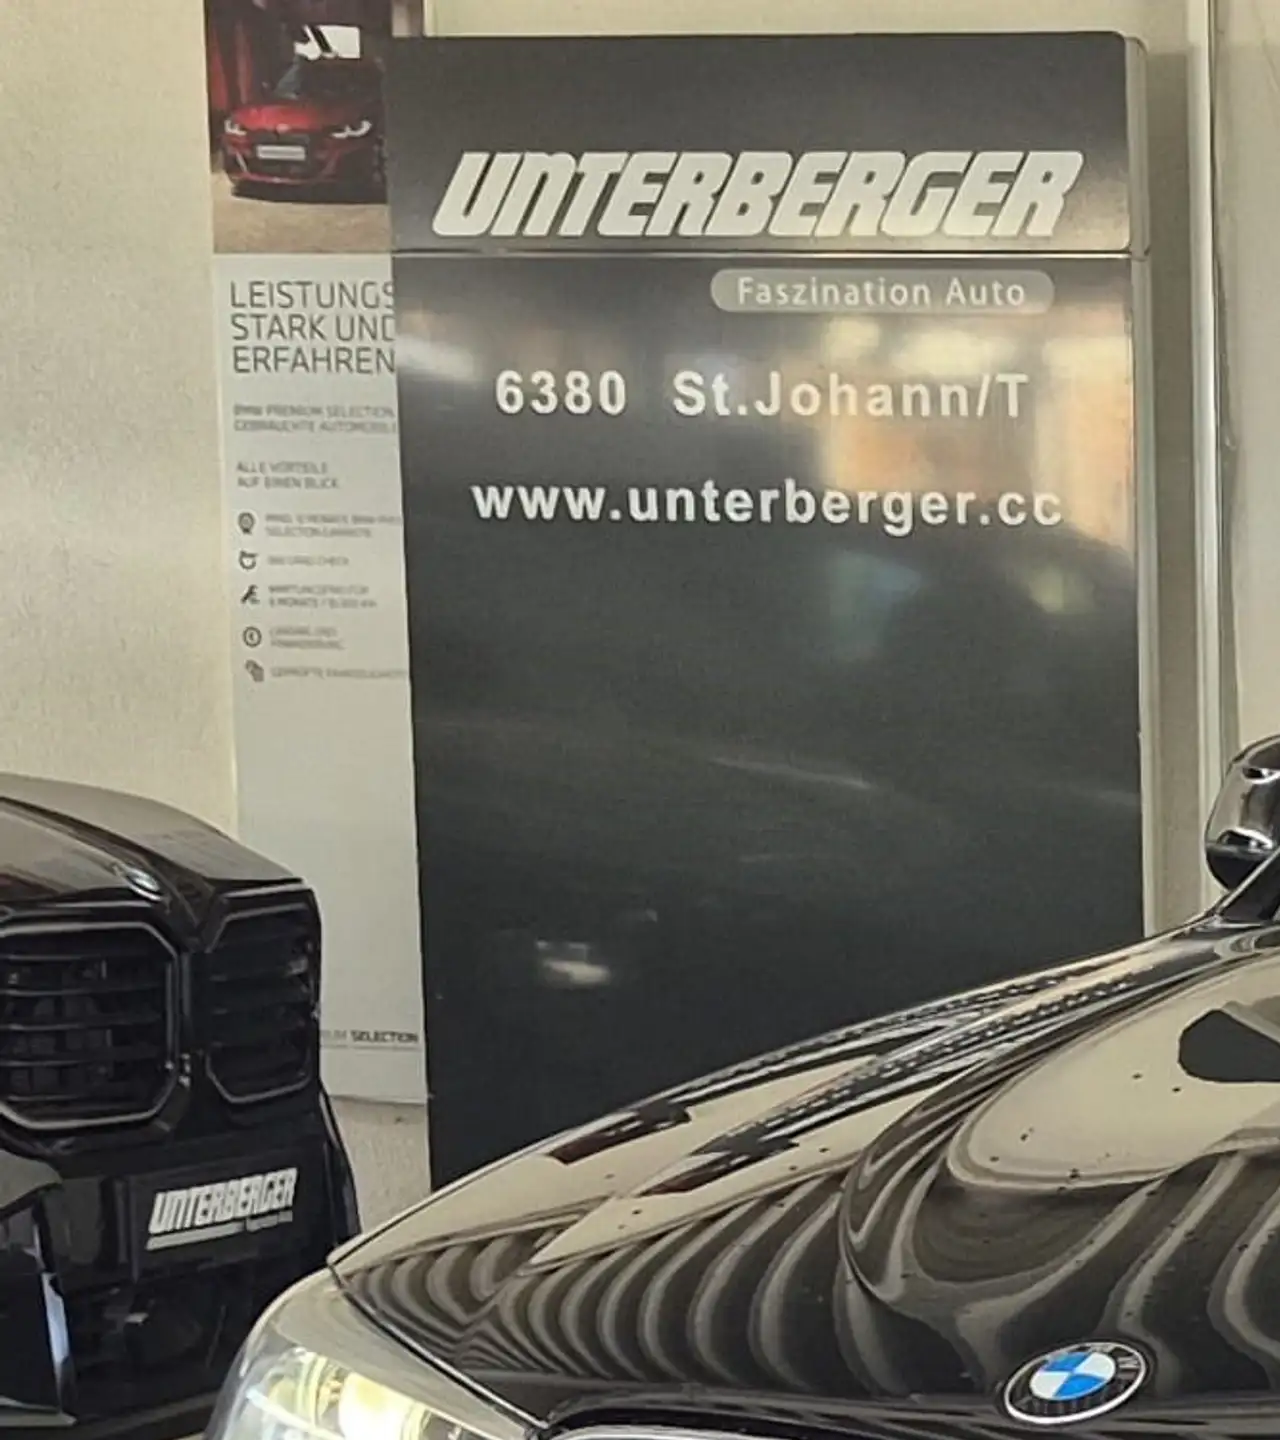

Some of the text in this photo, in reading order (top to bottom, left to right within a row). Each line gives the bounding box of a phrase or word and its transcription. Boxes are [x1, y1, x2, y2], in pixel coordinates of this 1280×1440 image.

[432, 150, 1085, 237] UNTERBERGER
[736, 276, 1026, 308] Faszination Auto
[230, 312, 328, 342] STARK
[232, 345, 396, 375] ERFAHREN
[496, 370, 1029, 418] 6380 St.Johann/T
[471, 478, 1063, 538] www.unterberger.cc
